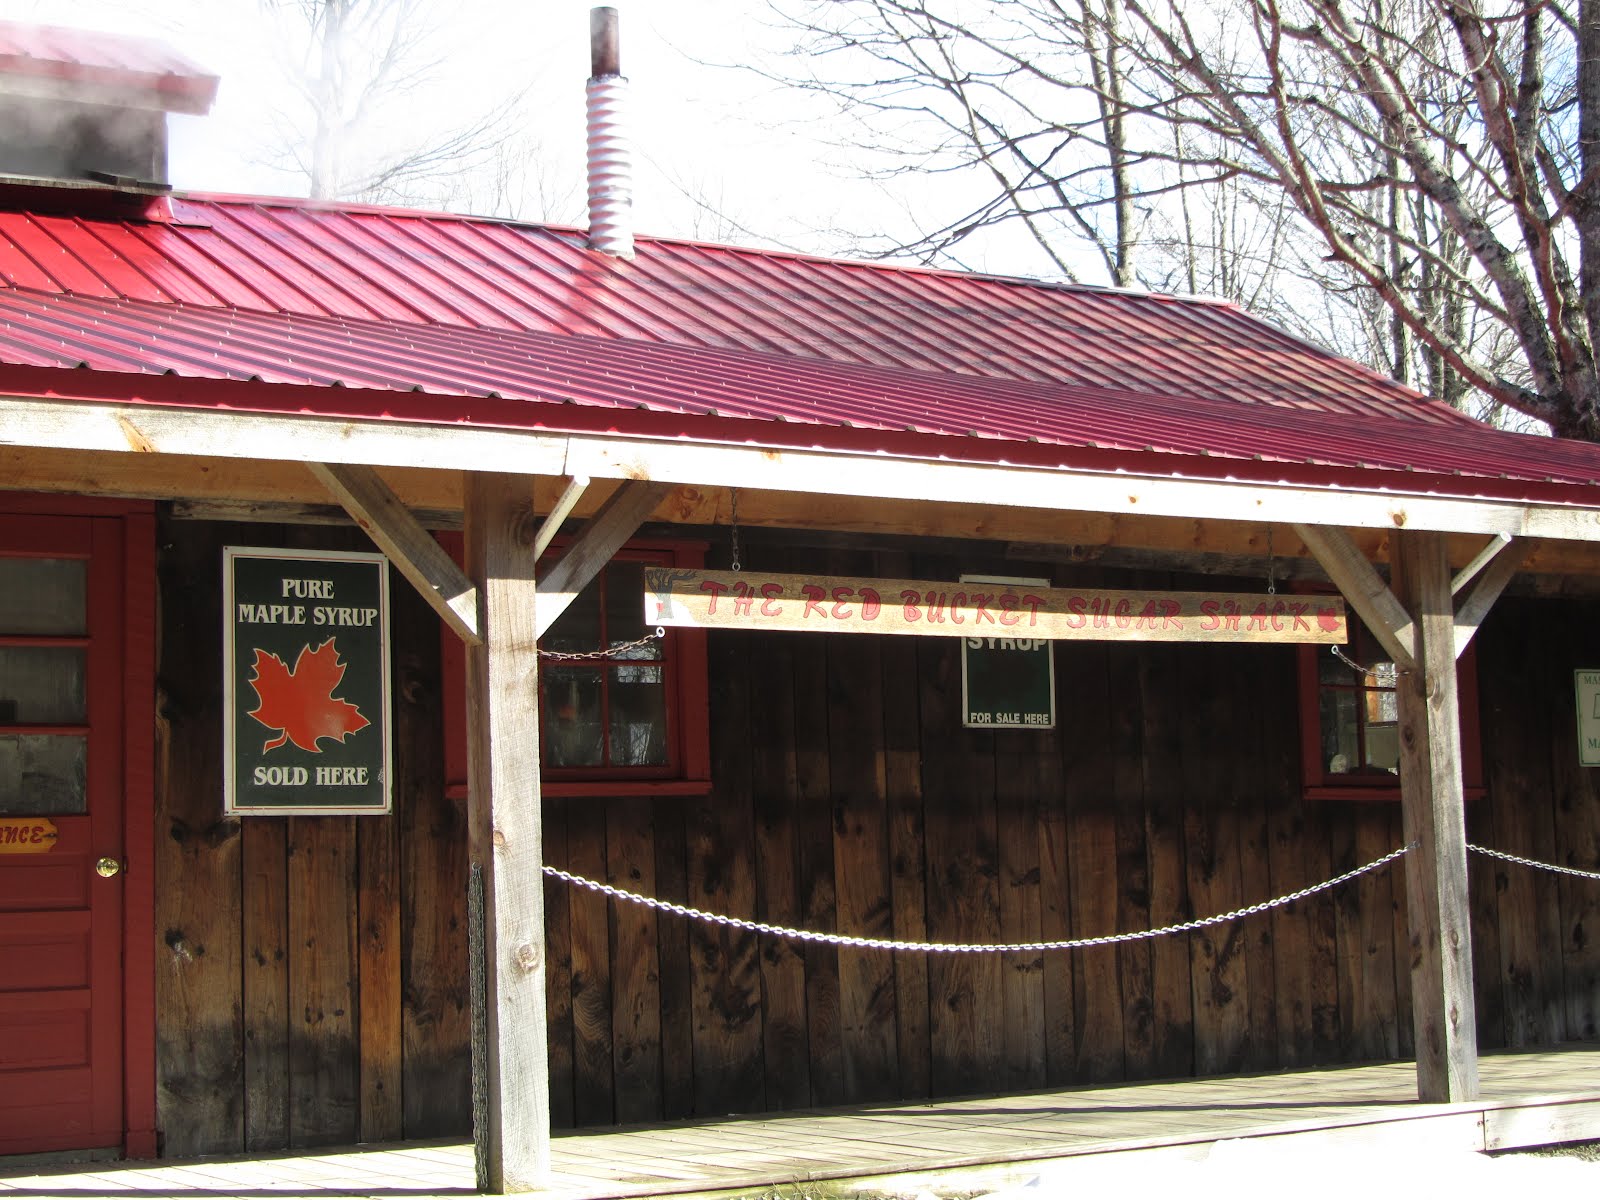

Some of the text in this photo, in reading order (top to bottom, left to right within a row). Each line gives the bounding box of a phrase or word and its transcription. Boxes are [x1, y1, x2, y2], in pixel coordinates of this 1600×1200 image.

[281, 578, 335, 599] PURE
[238, 603, 379, 627] MAPLE SYRUP
[700, 580, 1312, 633] THE RED BUCKET SUGAR SHACK
[967, 636, 1048, 652] SYRUP
[970, 712, 1049, 725] FOR SALE HERE
[253, 766, 370, 787] SOLD HERE
